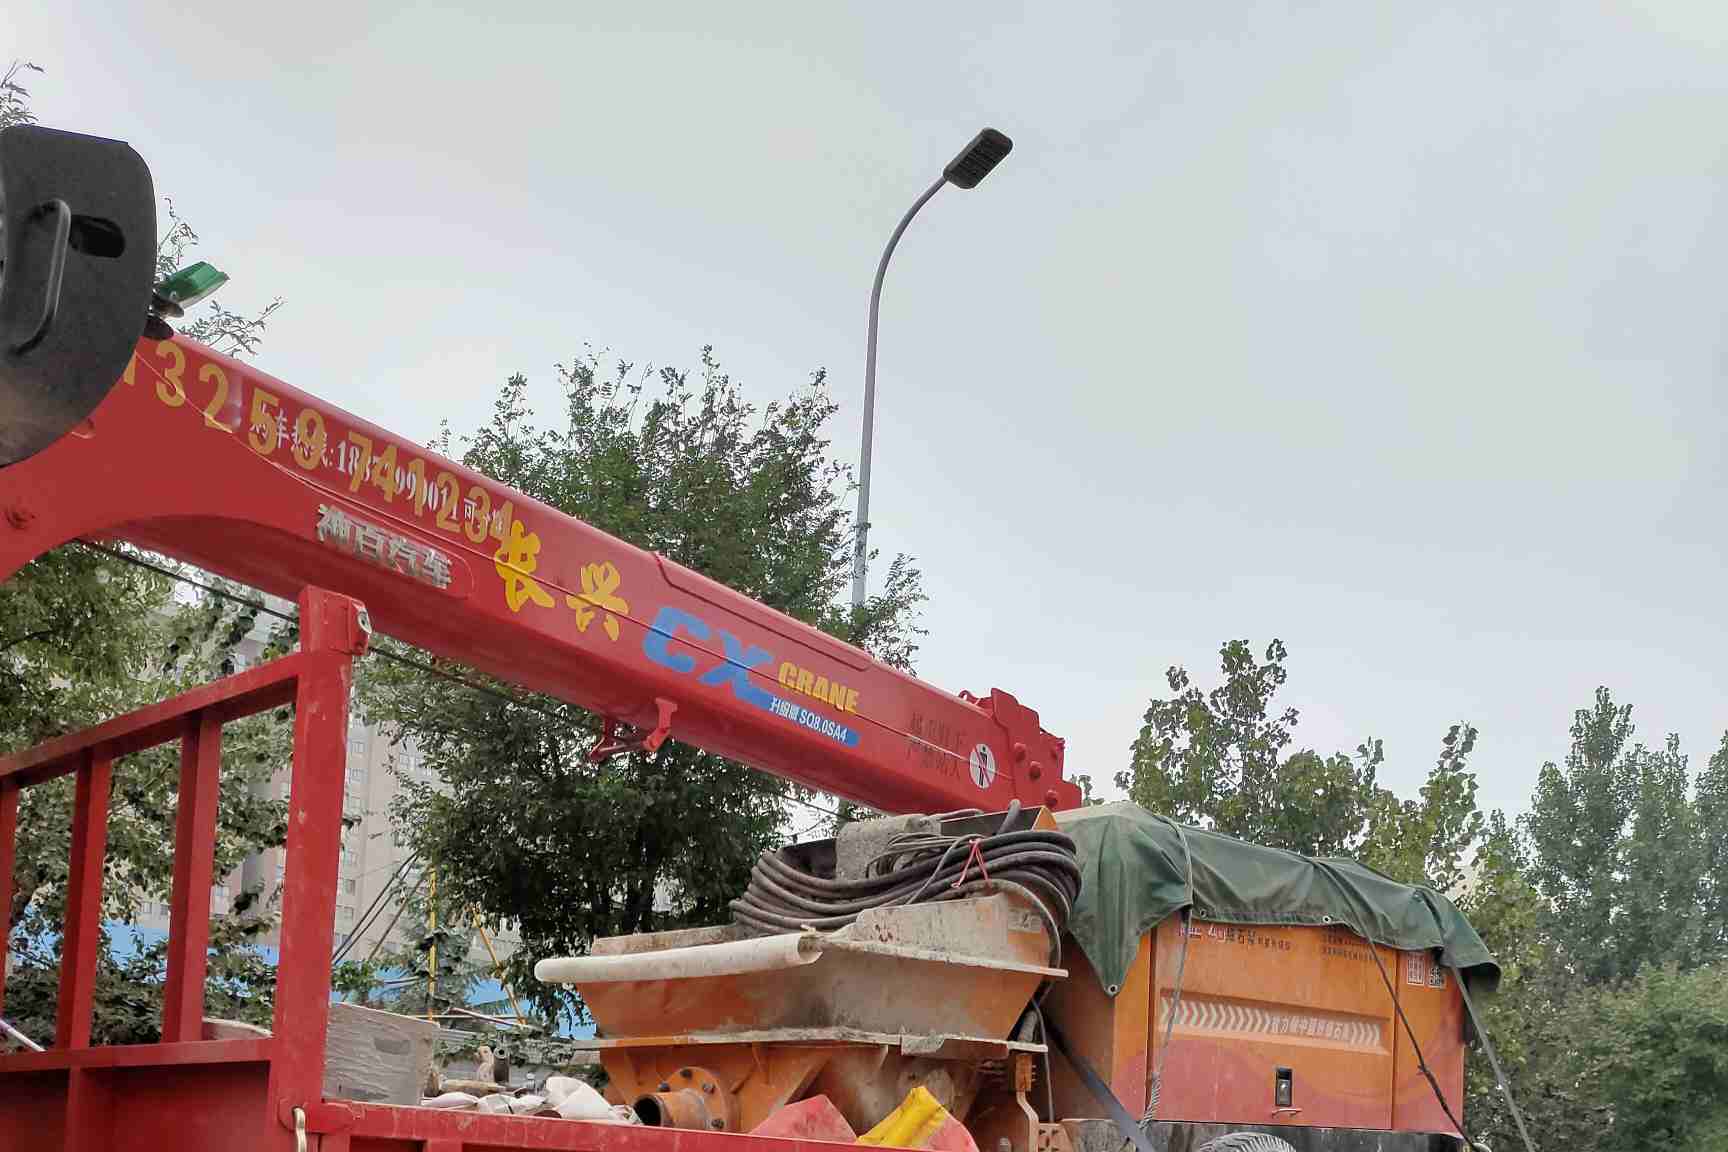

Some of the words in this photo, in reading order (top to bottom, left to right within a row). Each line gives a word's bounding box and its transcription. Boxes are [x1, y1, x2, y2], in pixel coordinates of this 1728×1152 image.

[642, 606, 775, 709] CX
[777, 661, 860, 714] CRANE
[798, 708, 848, 744] SQ8.0SA4
